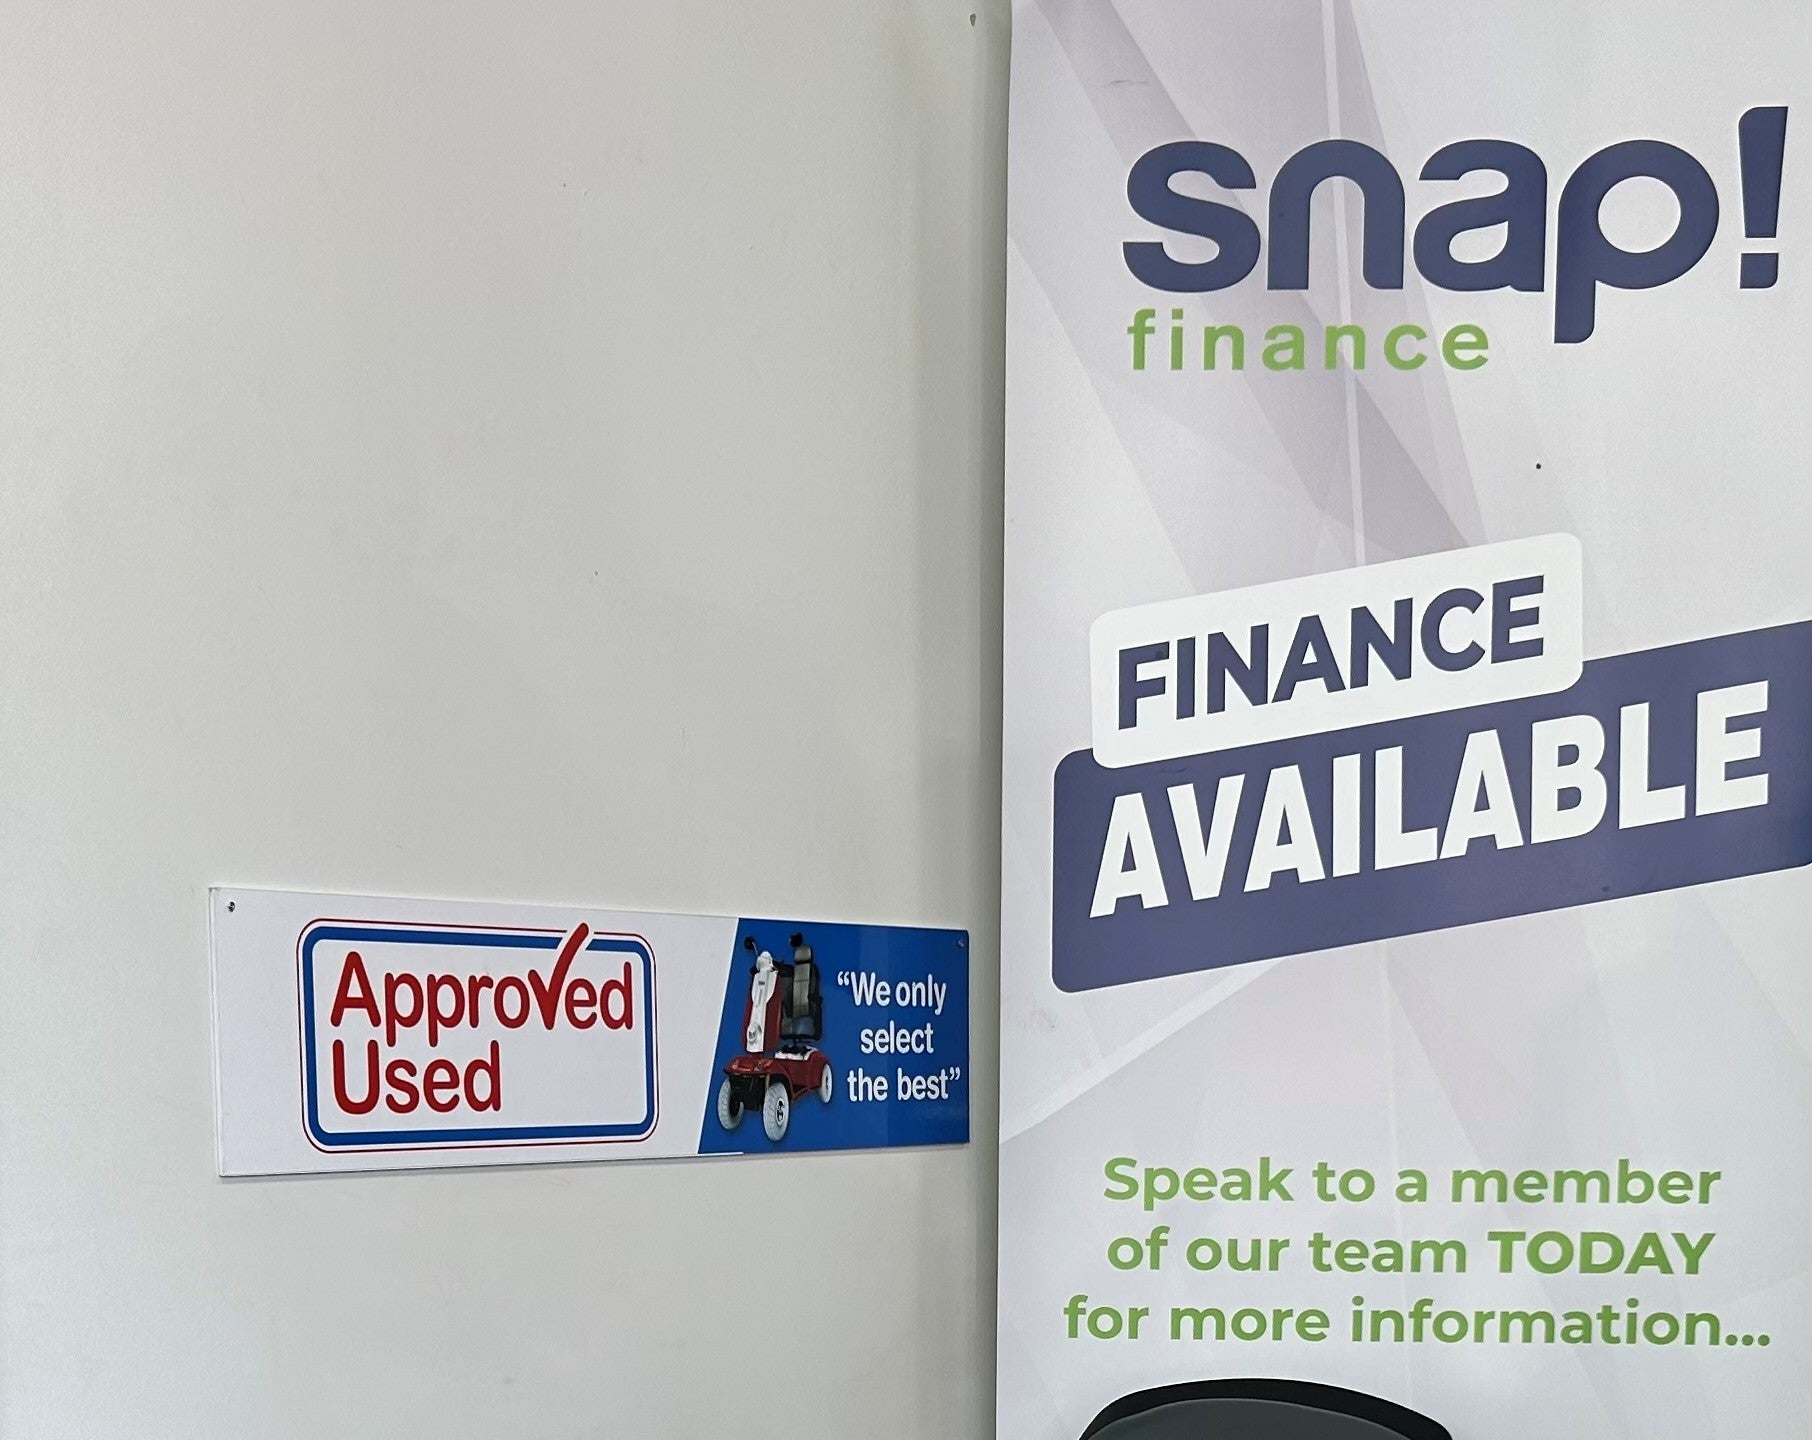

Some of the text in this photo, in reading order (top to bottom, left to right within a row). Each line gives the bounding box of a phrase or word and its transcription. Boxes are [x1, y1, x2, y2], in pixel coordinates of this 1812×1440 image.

[1123, 106, 1789, 344] snap!
[1127, 308, 1489, 371] finance
[1118, 575, 1545, 731] FINANCE
[1089, 680, 1769, 918] AVAILABLE
[330, 923, 634, 1048] Approved
[895, 973, 947, 1016] only
[860, 1020, 934, 1054] select
[332, 1040, 501, 1115] Used
[847, 1067, 889, 1102] the
[1103, 1156, 1722, 1211] Speak to a member
[1107, 1225, 1716, 1276] of our team TODAY
[1063, 1294, 1771, 1347] for more information...
